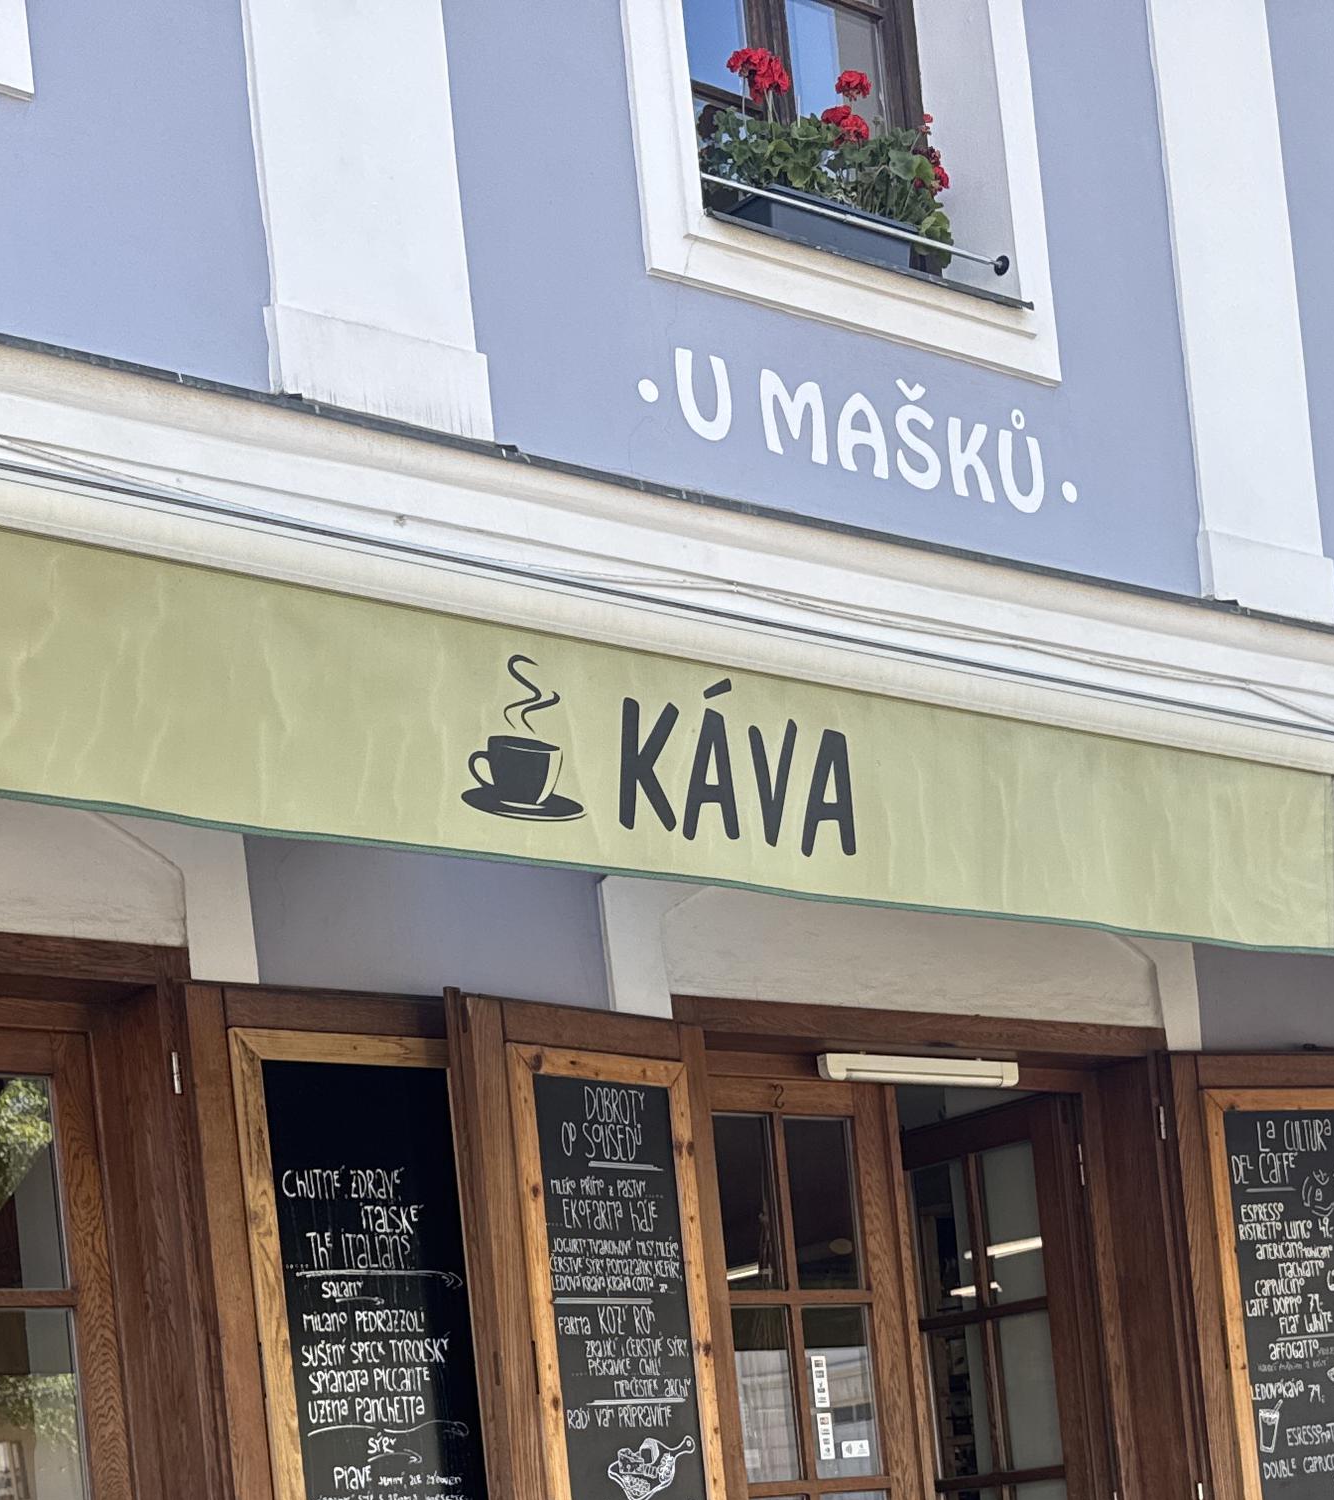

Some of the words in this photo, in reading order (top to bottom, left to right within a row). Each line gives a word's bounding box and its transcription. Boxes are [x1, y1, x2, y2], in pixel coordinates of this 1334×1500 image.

[674, 347, 733, 443] U
[757, 368, 1047, 516] MAŠKŮ
[618, 677, 857, 858] KÁVA
[584, 1086, 645, 1125] DOBROTY
